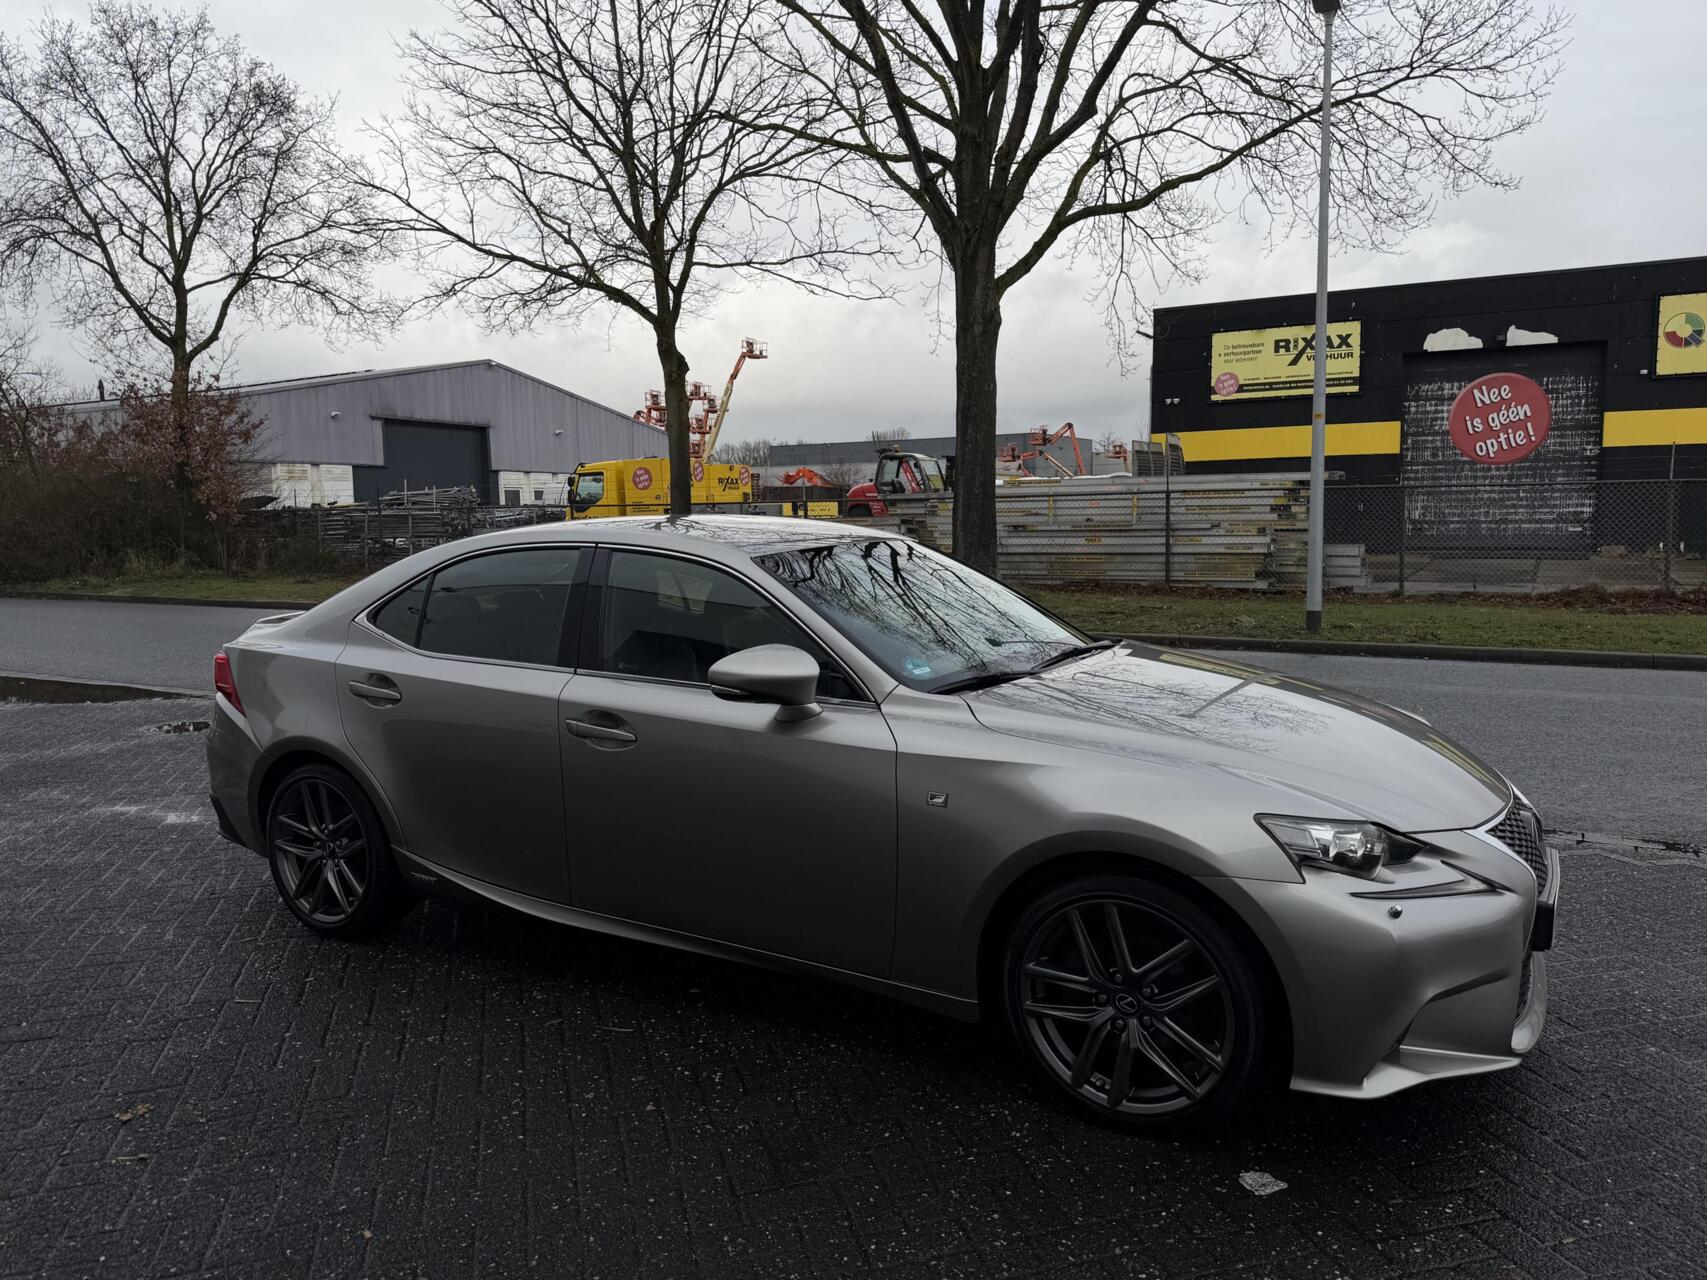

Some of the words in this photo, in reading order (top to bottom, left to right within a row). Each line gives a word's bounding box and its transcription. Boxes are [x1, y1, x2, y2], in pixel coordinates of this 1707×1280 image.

[1473, 384, 1512, 407] Nee
[1465, 415, 1484, 434] is
[1487, 401, 1532, 430] géén
[1475, 422, 1536, 458] optie!
